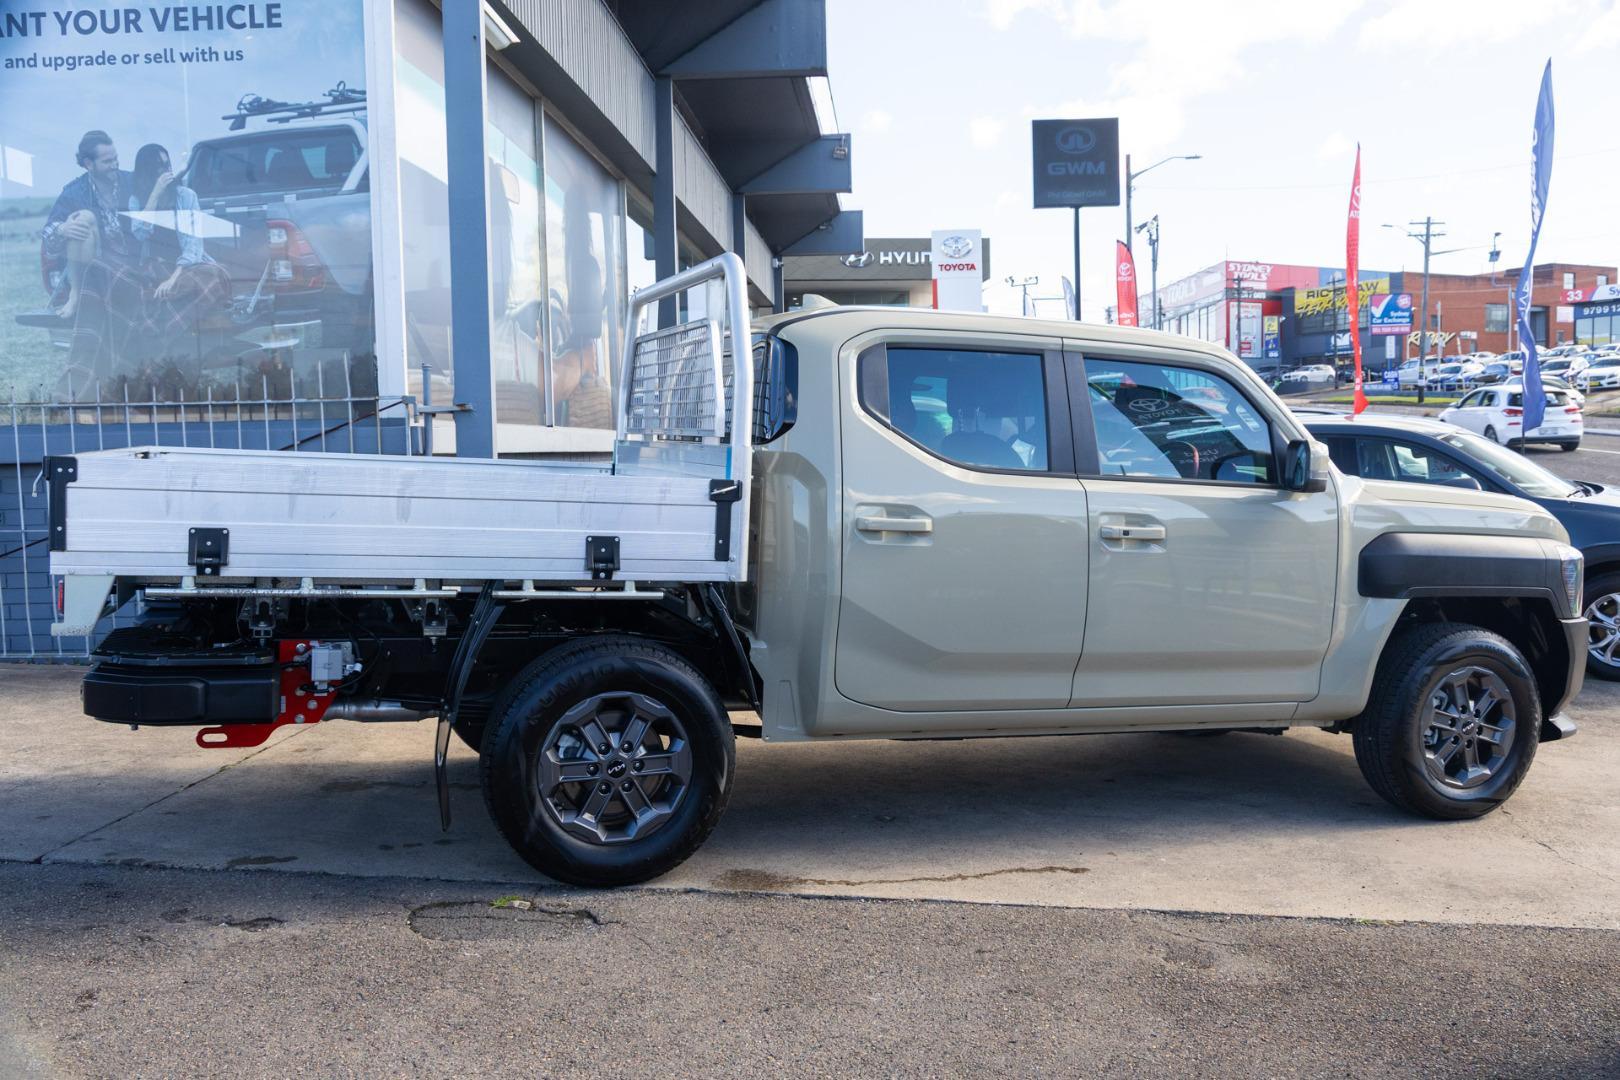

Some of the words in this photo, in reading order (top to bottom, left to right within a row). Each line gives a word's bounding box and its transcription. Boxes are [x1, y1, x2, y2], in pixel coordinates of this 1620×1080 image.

[53, 8, 143, 36] YOUR
[149, 3, 282, 32] VEHICLE
[4, 52, 38, 69] and
[42, 50, 117, 71] upgrade
[121, 53, 140, 65] or
[144, 47, 176, 64] sell
[179, 46, 219, 63] with
[223, 48, 245, 62] us
[1047, 160, 1105, 176] GWM
[938, 263, 977, 272] TOYOTA
[1228, 262, 1273, 273] SYDNEY
[1233, 271, 1268, 281] TOOLS
[1566, 290, 1583, 302] 33
[1390, 310, 1410, 319] Sydney
[1383, 316, 1411, 325] Exchange
